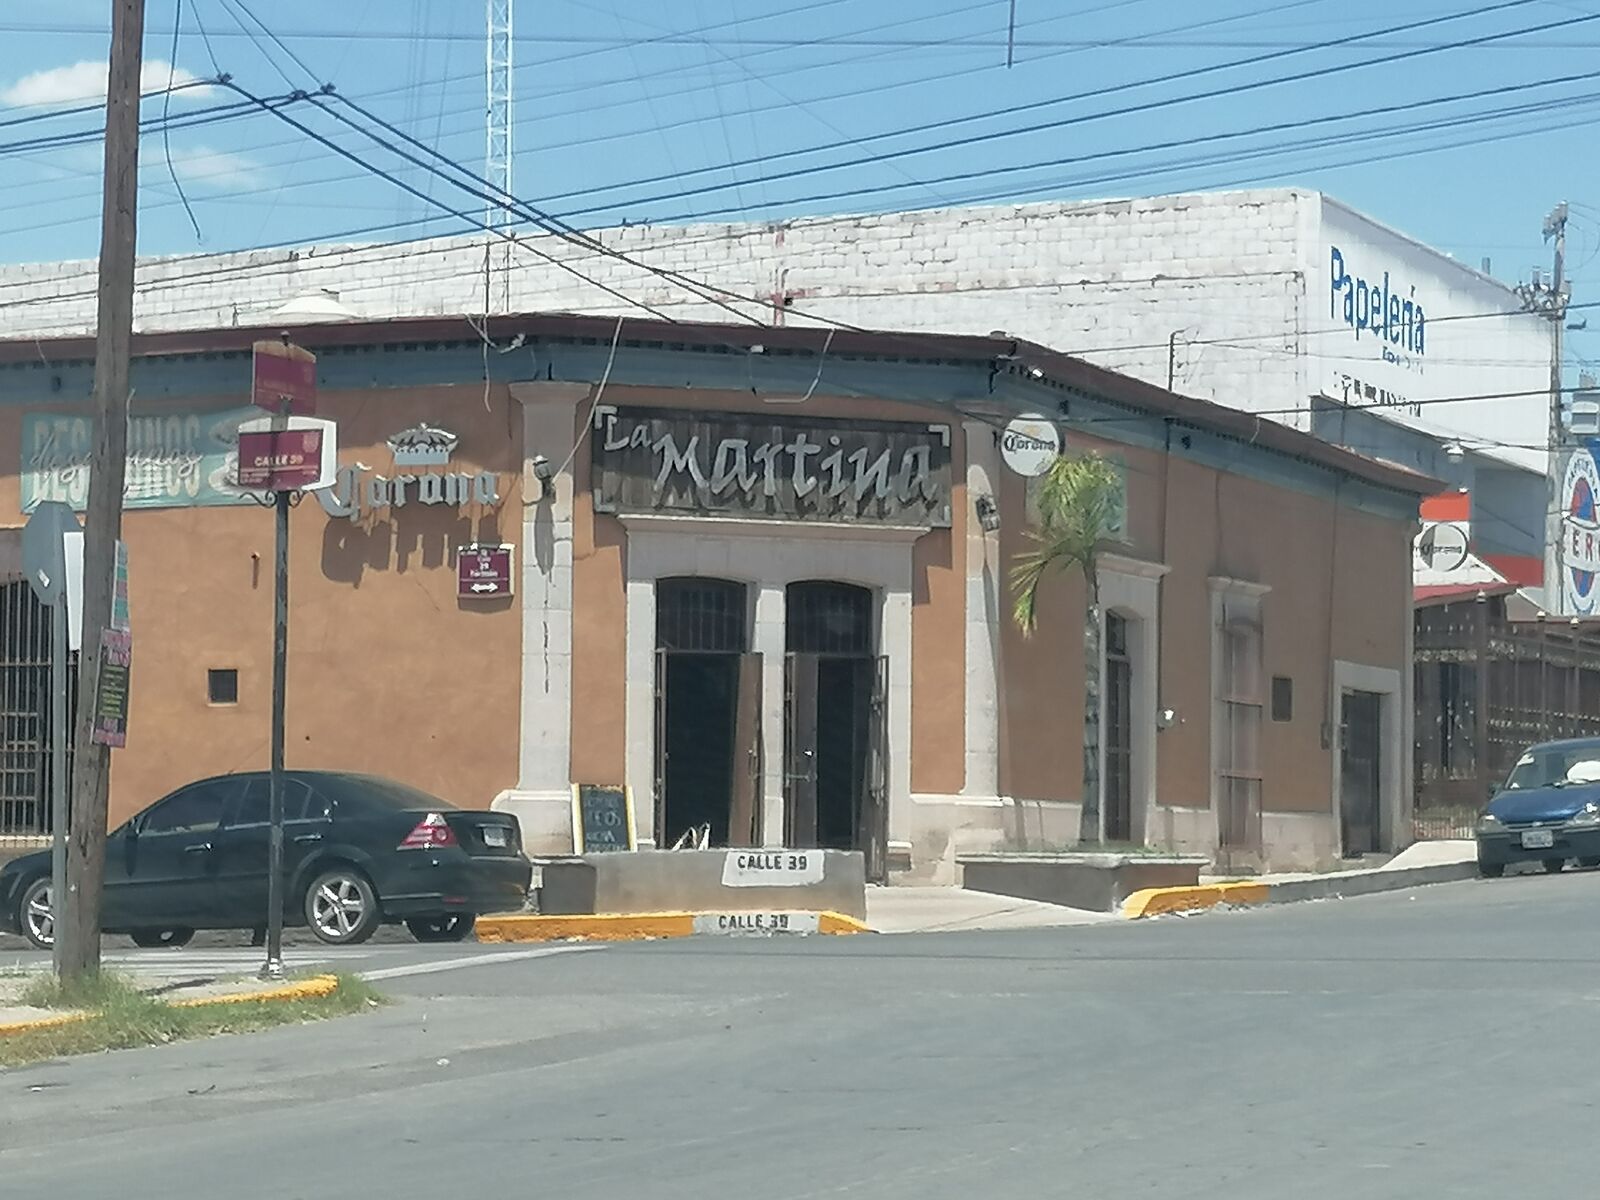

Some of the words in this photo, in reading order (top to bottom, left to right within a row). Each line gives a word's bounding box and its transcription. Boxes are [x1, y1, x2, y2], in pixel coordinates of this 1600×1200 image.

[604, 415, 651, 450] La
[651, 433, 938, 502] Martina
[737, 855, 782, 870] CALLE
[788, 855, 808, 870] 39
[718, 914, 763, 929] CALLE
[769, 914, 789, 929] 39
